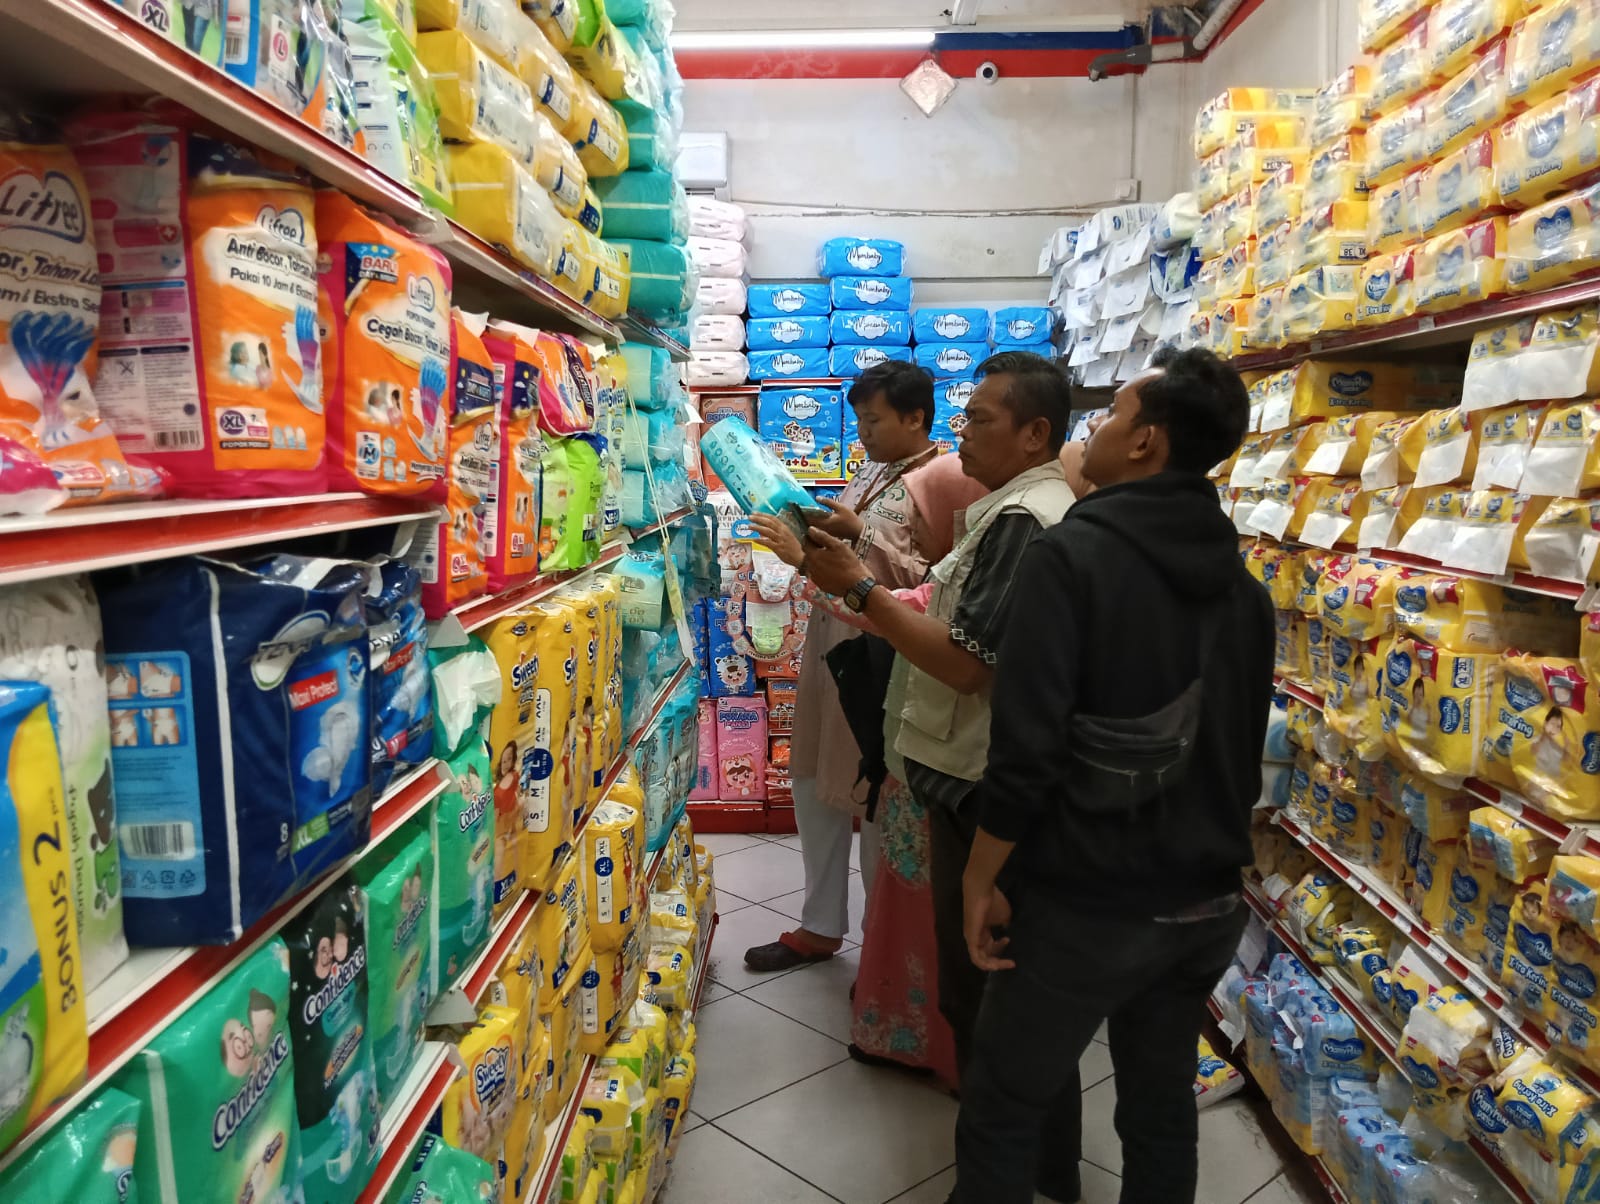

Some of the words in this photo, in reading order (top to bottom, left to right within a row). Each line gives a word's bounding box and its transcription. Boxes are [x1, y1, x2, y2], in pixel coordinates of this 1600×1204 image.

[143, 8, 169, 32] XL
[227, 237, 256, 258] Anti
[256, 245, 288, 269] Bocor,
[1343, 248, 1352, 256] 38
[34, 255, 81, 281] Tahan
[230, 267, 261, 284] Pakai
[262, 273, 272, 287] 10
[34, 290, 80, 309] Ekstra
[367, 318, 403, 339] Cegah
[224, 414, 243, 429] XL
[362, 446, 377, 460] M
[715, 505, 747, 516] KAN
[530, 788, 540, 798] M
[529, 811, 540, 820] S
[280, 822, 289, 843] 8
[33, 829, 61, 869] 2
[599, 861, 607, 873] XL
[49, 869, 78, 1014] BONUS
[303, 945, 365, 1025] Confidence
[425, 1138, 434, 1148] M
